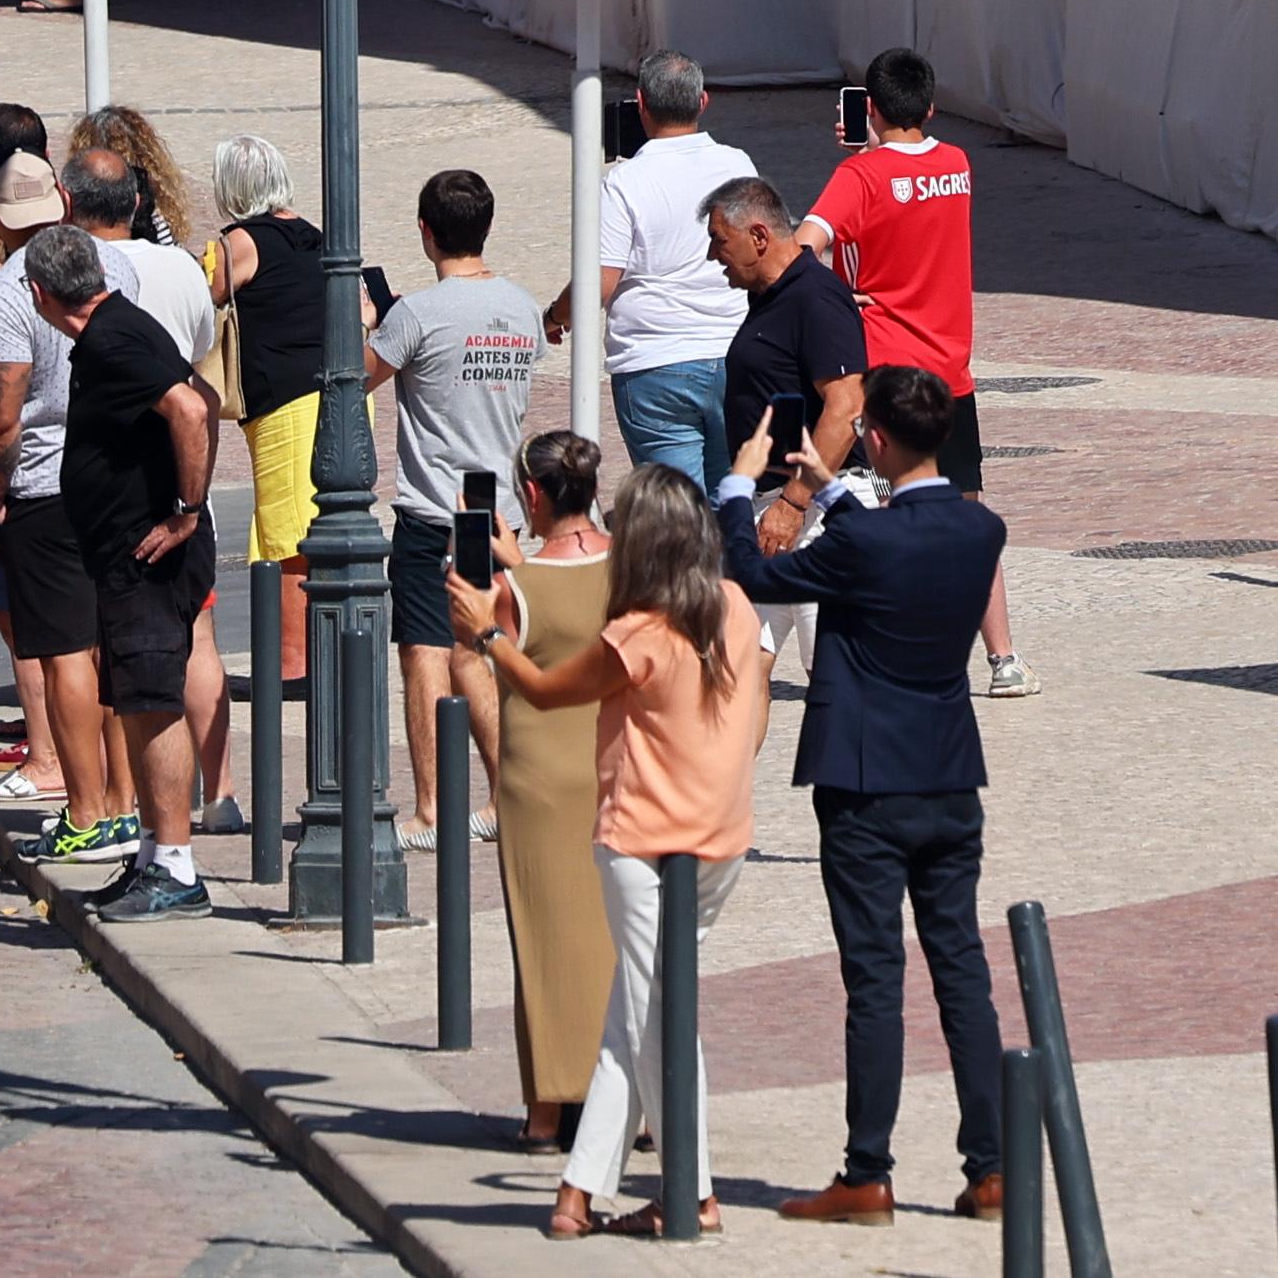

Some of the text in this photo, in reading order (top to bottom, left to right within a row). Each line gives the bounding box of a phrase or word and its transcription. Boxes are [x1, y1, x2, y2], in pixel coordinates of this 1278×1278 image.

[464, 334, 534, 349] ACADEMIA
[462, 350, 533, 365] ARTES DE
[462, 367, 529, 382] COMBATE
